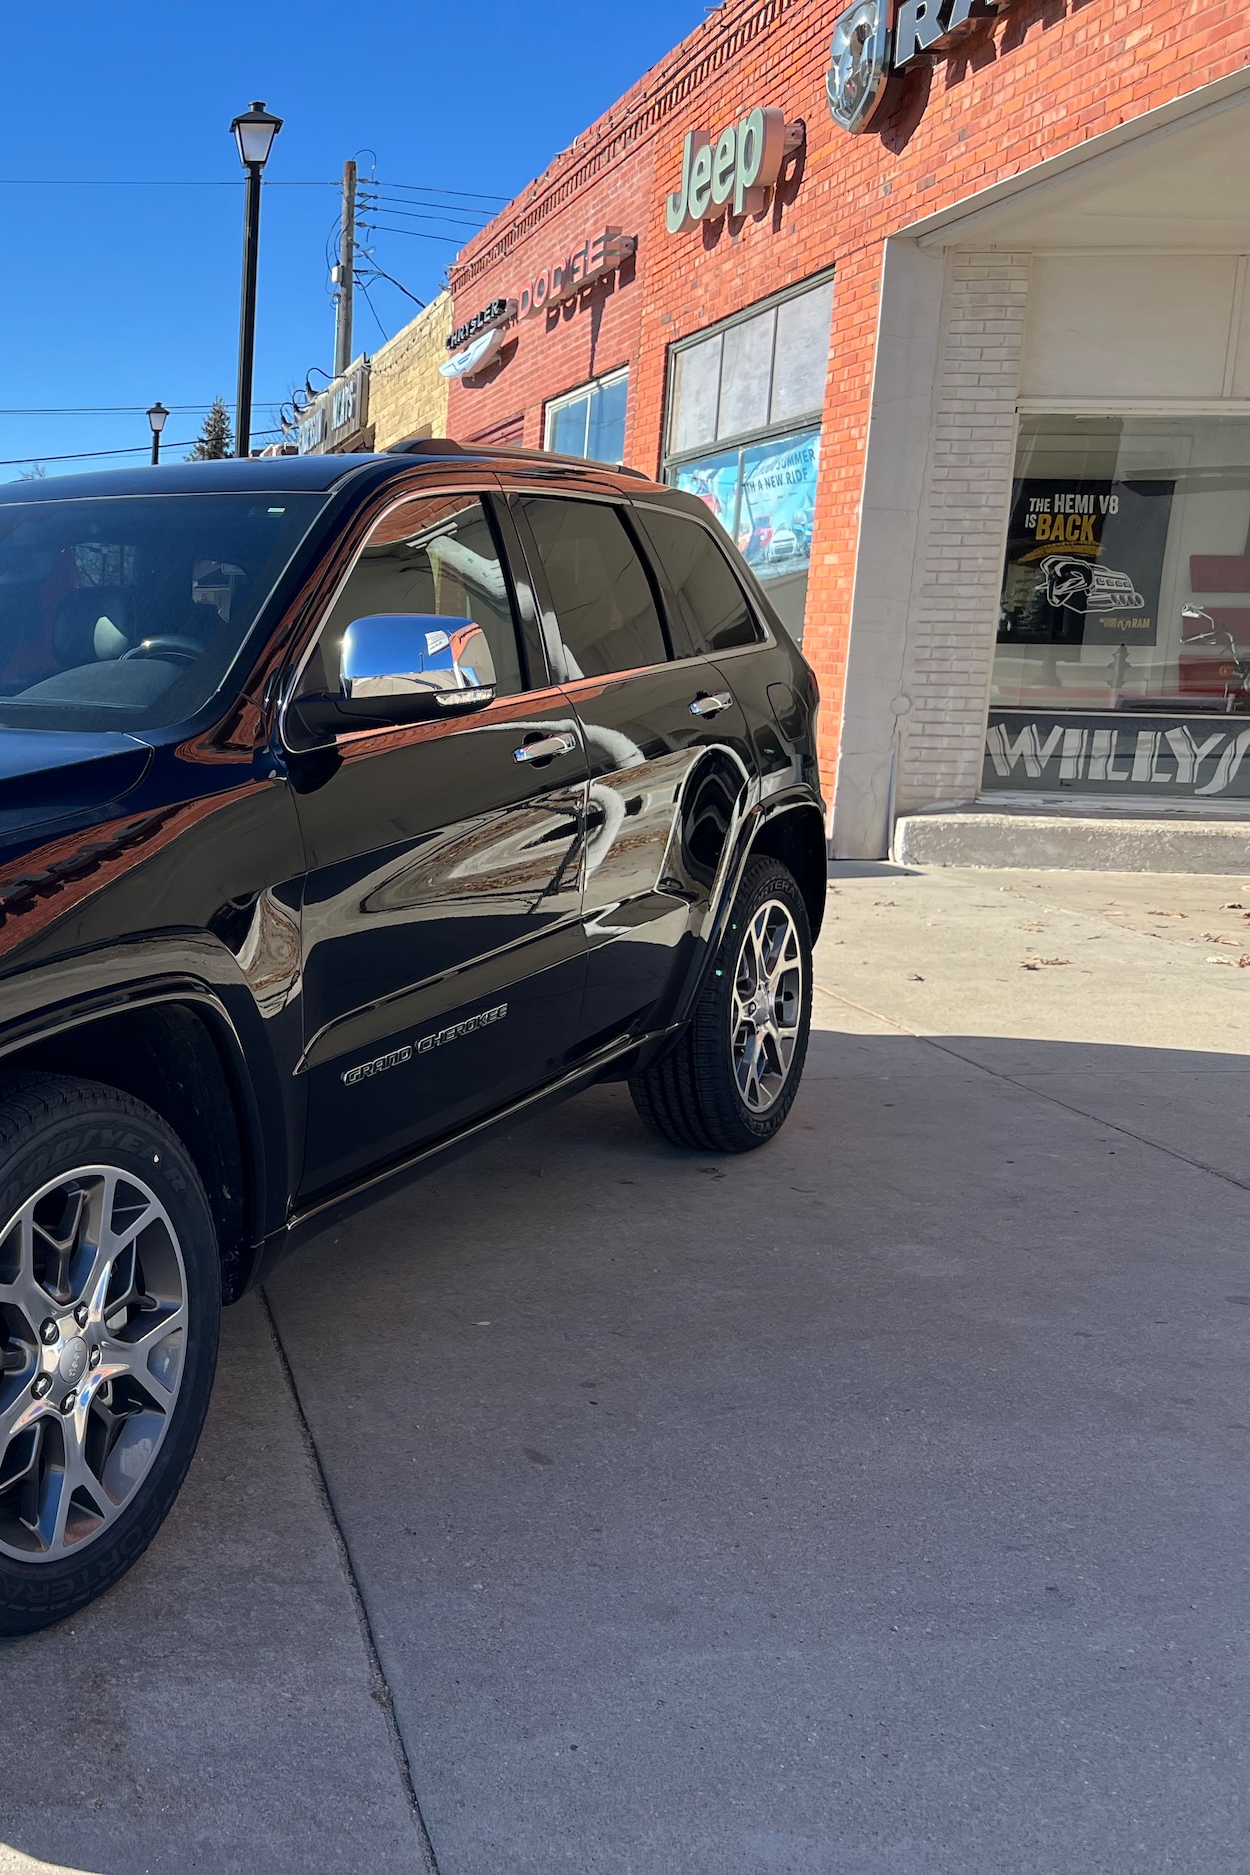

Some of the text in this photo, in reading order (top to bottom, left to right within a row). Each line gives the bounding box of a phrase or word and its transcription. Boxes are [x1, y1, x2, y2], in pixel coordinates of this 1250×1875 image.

[666, 107, 772, 234] Jeep
[518, 226, 619, 321] DODGE
[446, 299, 502, 350] CHRYSLER
[764, 473, 783, 490] NEW
[1029, 494, 1119, 515] THE HEMI V8
[1025, 514, 1096, 541] IS BACK
[1132, 618, 1150, 628] RAM
[986, 722, 1250, 794] WILLYS
[340, 1003, 508, 1087] GRAND CHEROKEE
